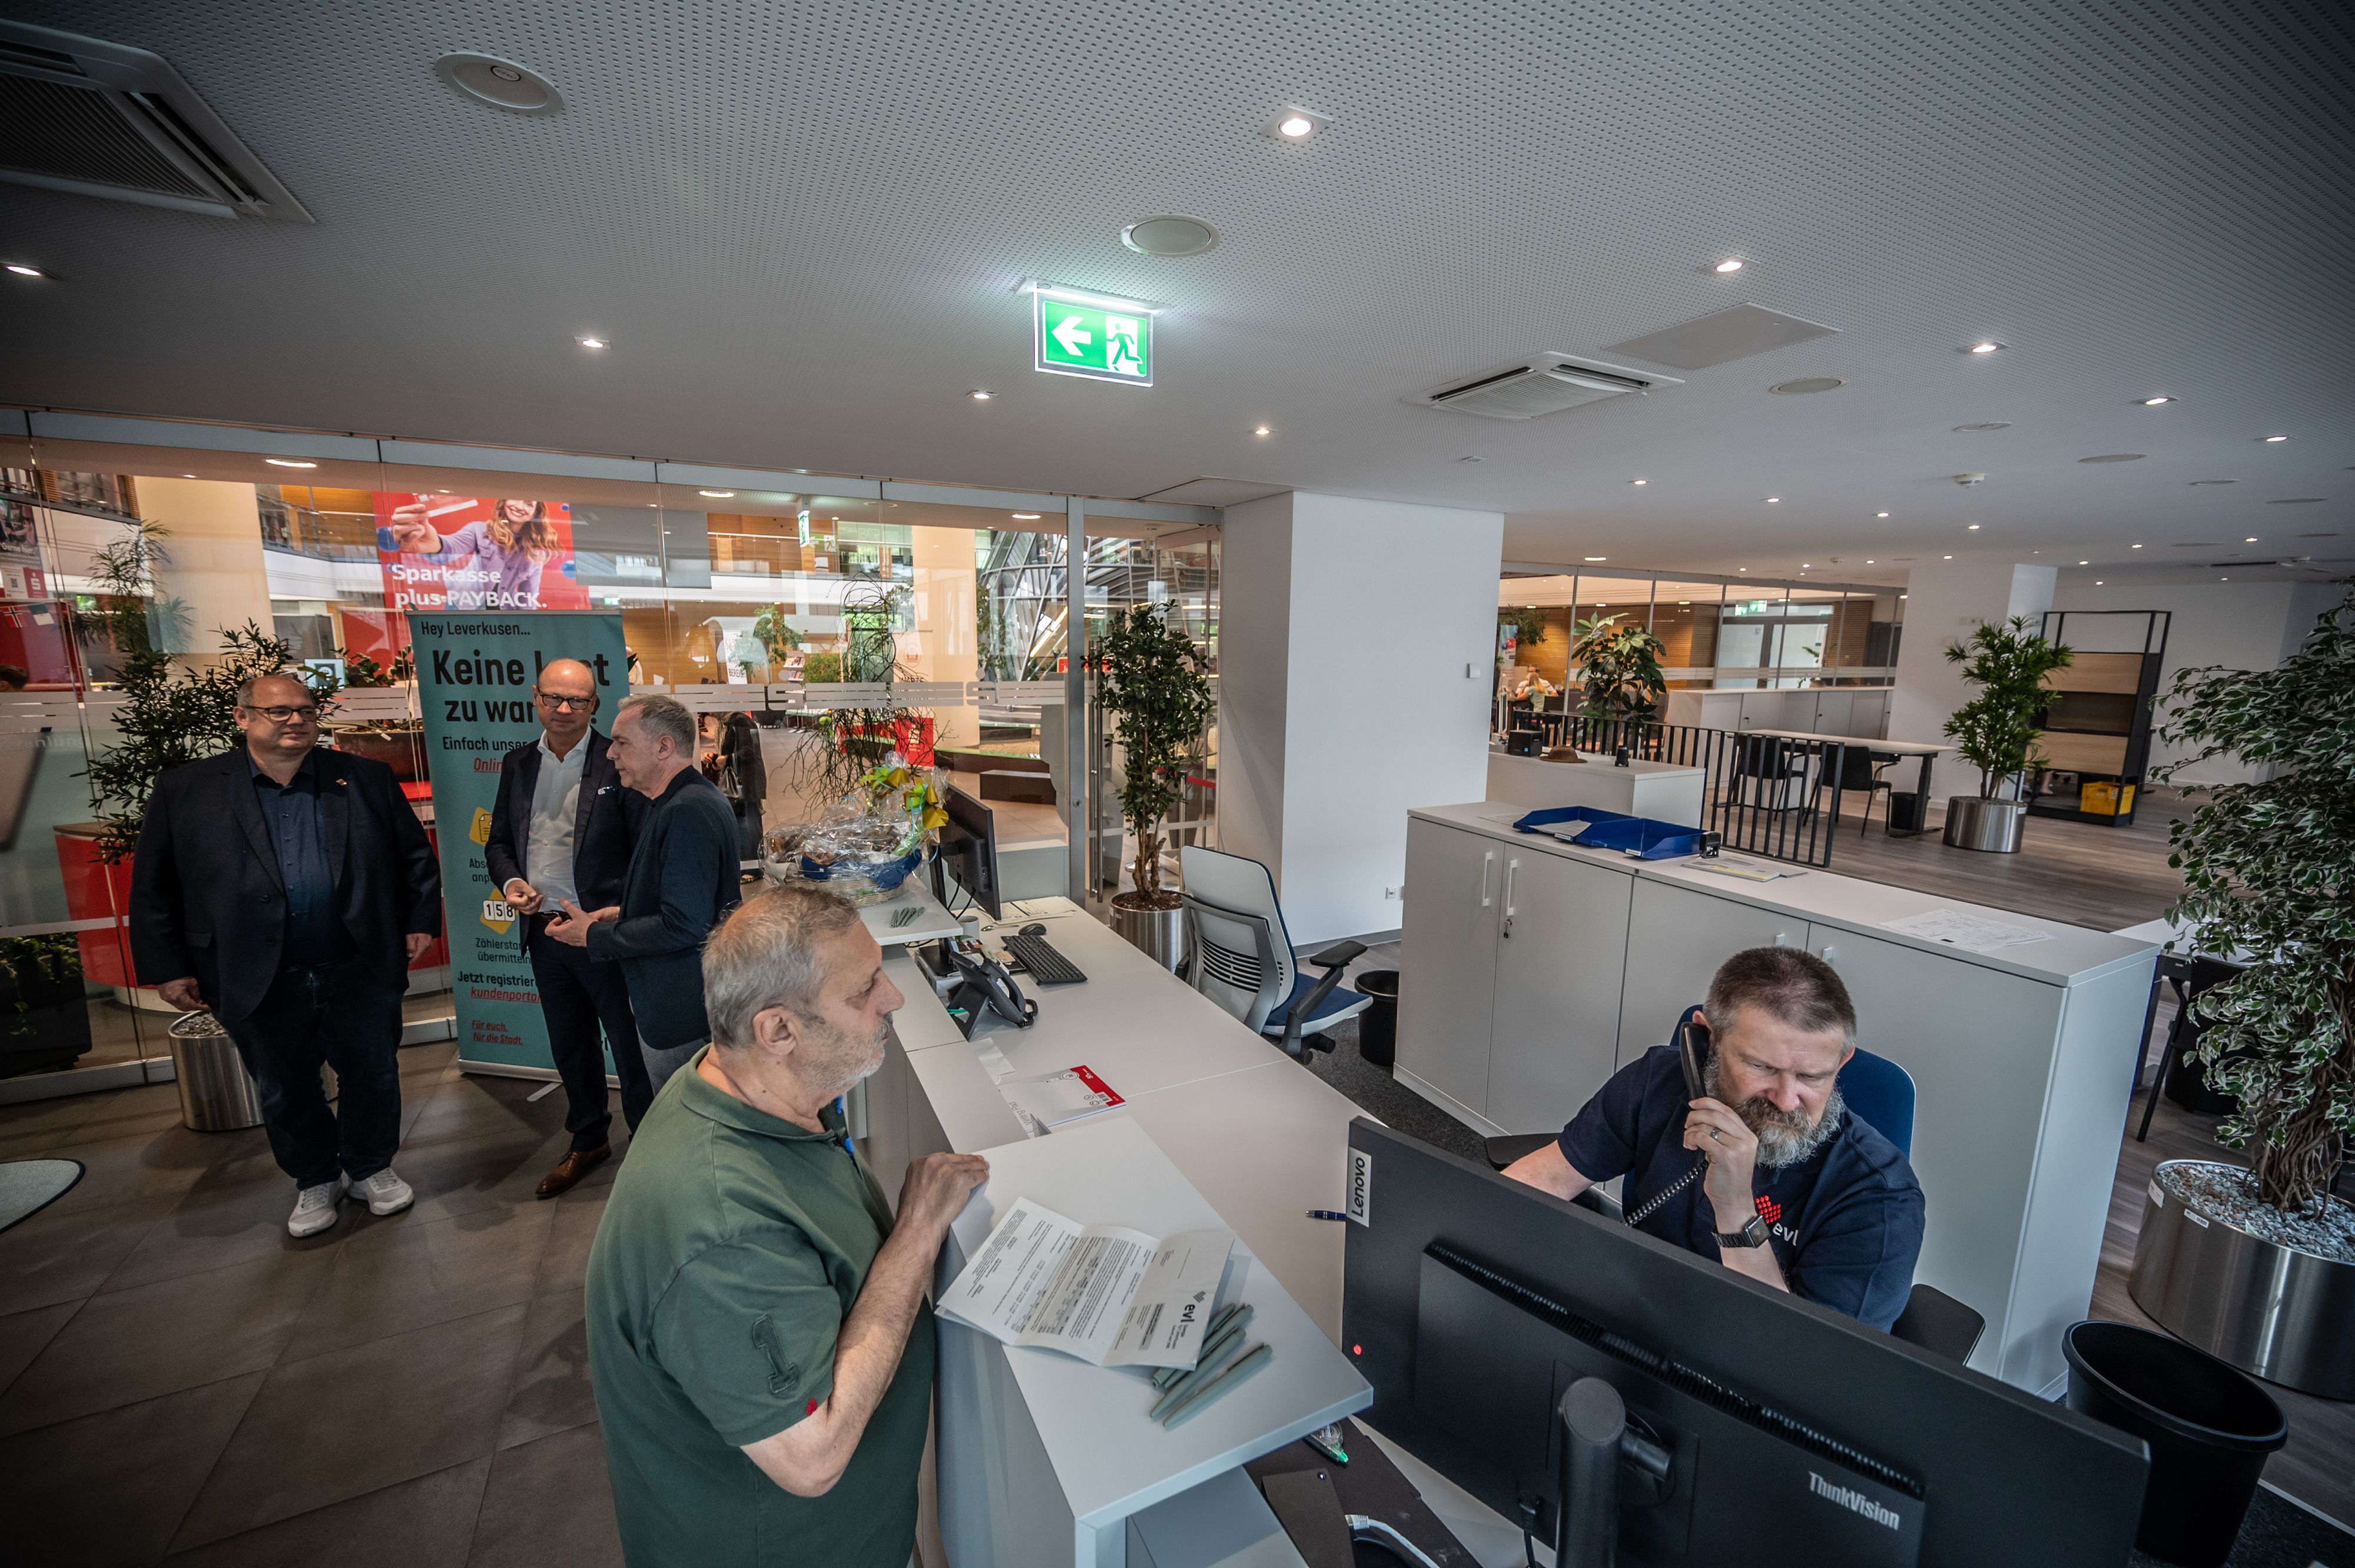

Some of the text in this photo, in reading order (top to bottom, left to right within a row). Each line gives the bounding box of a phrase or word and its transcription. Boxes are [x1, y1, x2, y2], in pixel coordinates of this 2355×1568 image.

[391, 564, 501, 584] Sparkasse
[396, 589, 548, 609] plus PAYBACK.
[421, 621, 530, 638] Hey Leverkusen...
[433, 649, 525, 686] Keine
[445, 700, 478, 722] zu
[443, 736, 489, 751] Einfach
[473, 757, 503, 772] Onlin
[472, 873, 490, 885] anp
[475, 938, 521, 951] Zählersta
[457, 971, 536, 987] Jetzt registrier
[472, 1019, 484, 1029] Für
[473, 1032, 524, 1045] für die Stadt.
[1351, 1157, 1365, 1218] Lenovo
[1772, 1222, 1799, 1246] evl
[1180, 1304, 1196, 1323] evl
[1808, 1470, 1900, 1530] ThinkVision
